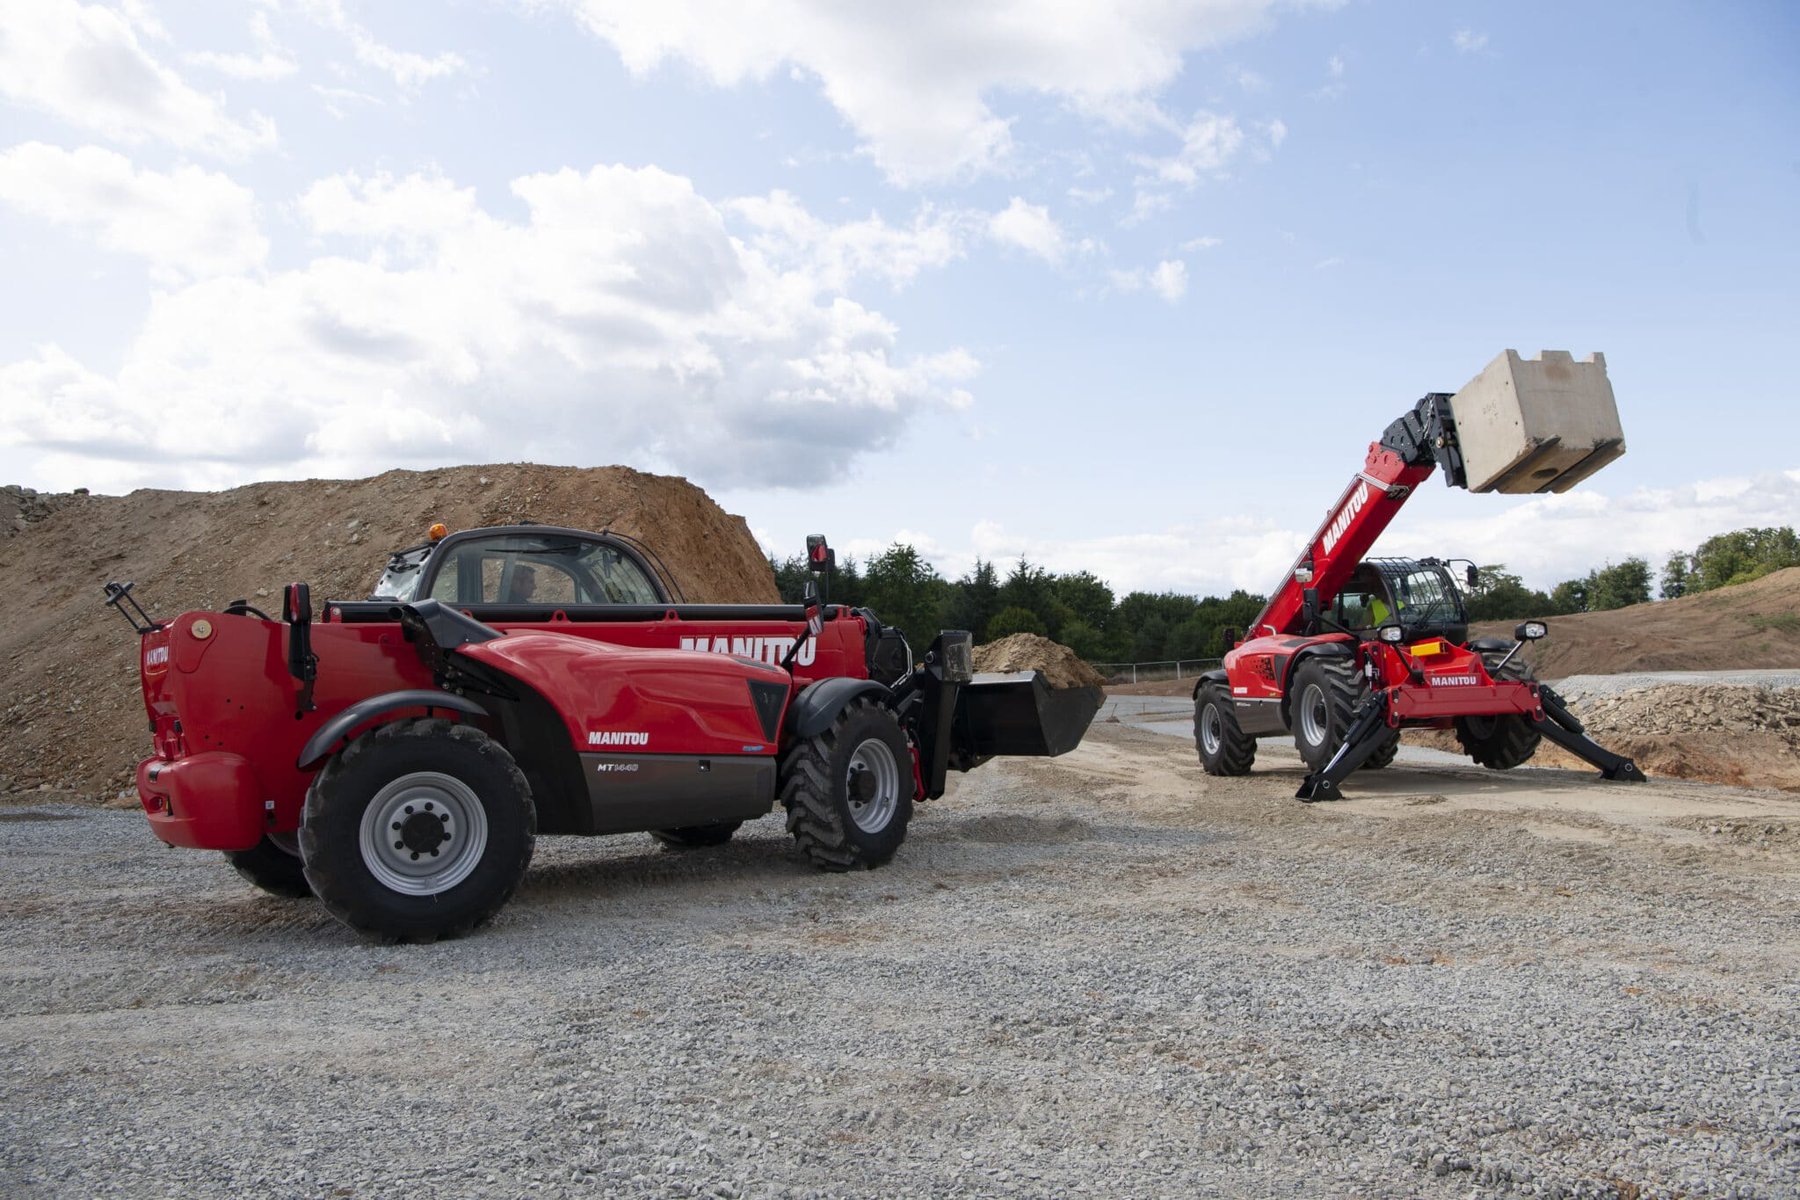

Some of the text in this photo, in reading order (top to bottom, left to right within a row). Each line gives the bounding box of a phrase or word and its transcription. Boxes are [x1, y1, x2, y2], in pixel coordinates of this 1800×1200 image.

[1322, 480, 1368, 556] MANITOU
[1431, 676, 1477, 686] MANITOU
[588, 731, 649, 745] MANITOU
